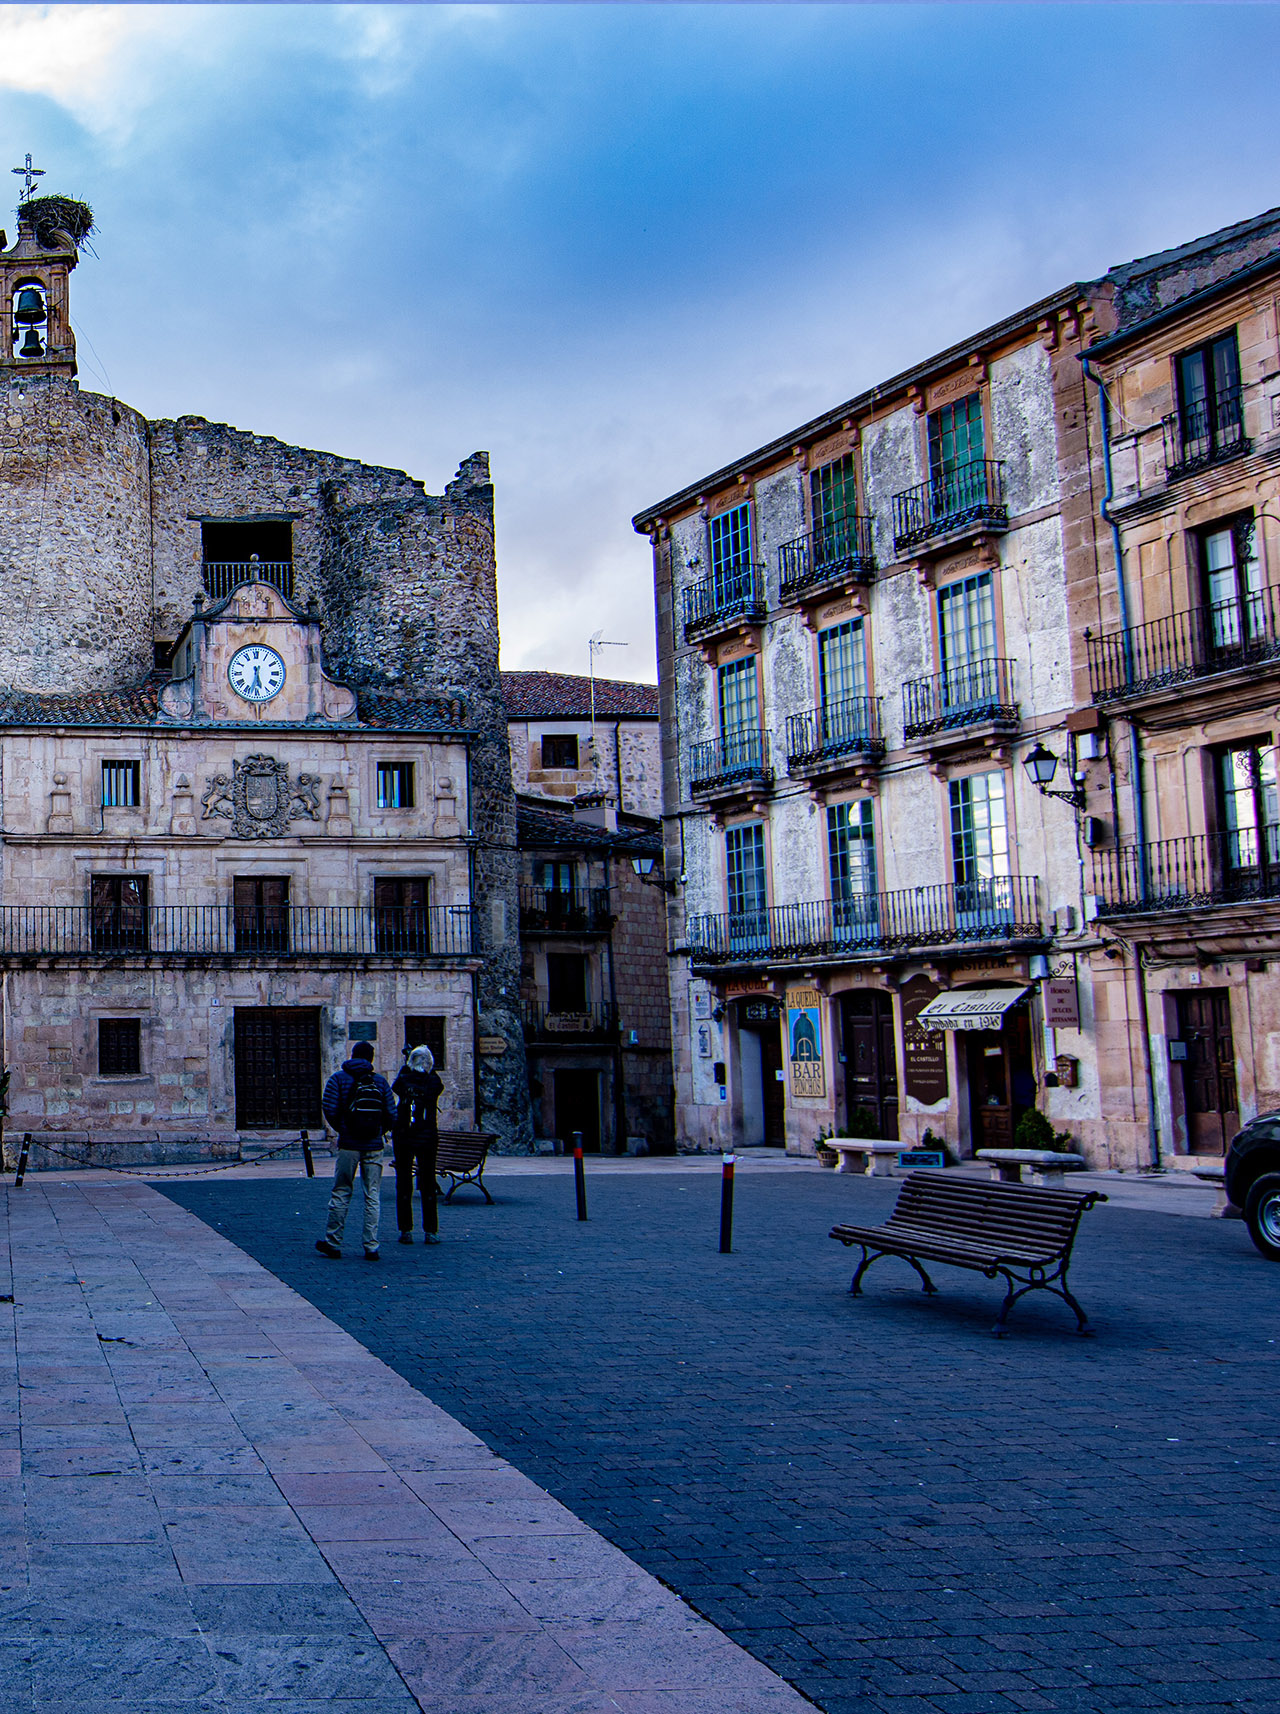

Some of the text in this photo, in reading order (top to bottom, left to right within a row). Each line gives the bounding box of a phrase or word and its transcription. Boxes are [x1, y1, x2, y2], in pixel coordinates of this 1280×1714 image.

[741, 977, 767, 992] QUED
[796, 991, 818, 1007] QUEDA
[927, 1001, 1006, 1013] El Castillo
[963, 1019, 973, 1028] en
[792, 1062, 821, 1078] BAR
[794, 1079, 821, 1095] PINCHOS
